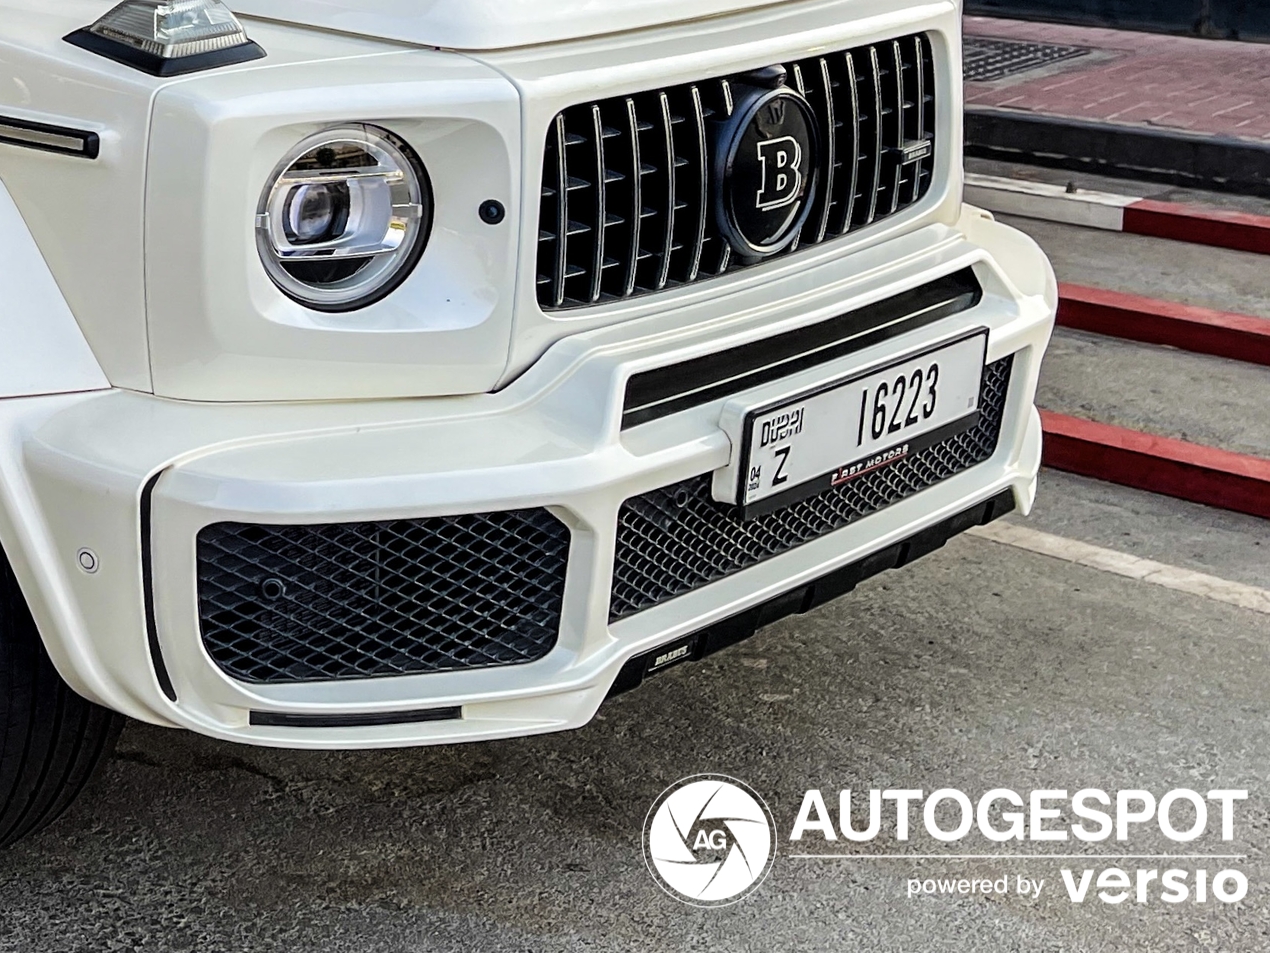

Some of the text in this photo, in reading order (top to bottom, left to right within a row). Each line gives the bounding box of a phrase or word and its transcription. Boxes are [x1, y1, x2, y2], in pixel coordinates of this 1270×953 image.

[756, 136, 801, 211] B
[856, 362, 939, 448] 16223
[772, 445, 792, 487] Z
